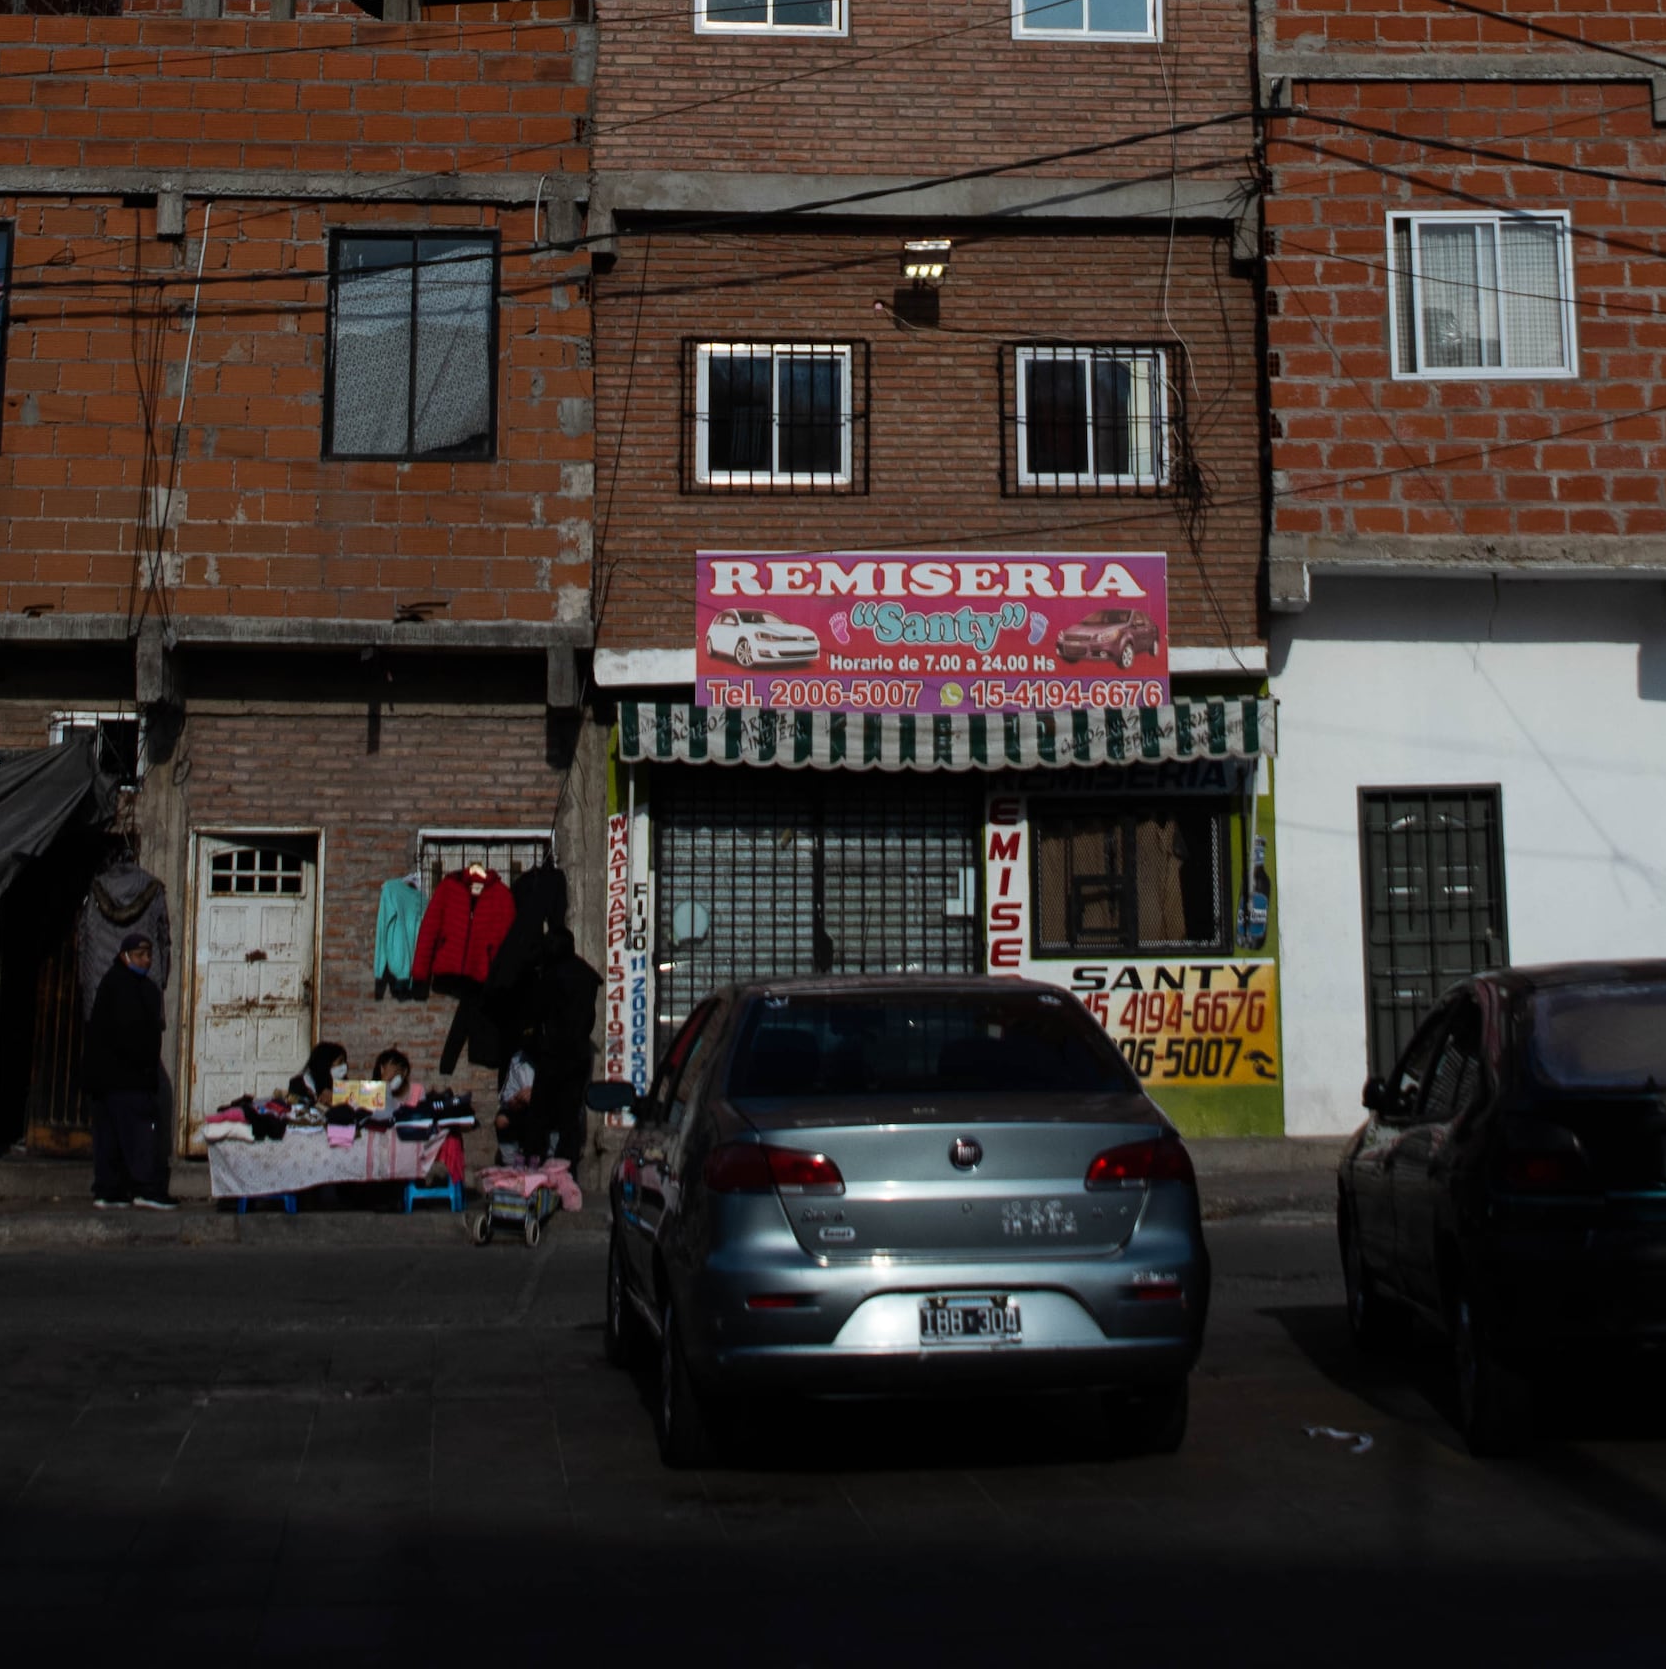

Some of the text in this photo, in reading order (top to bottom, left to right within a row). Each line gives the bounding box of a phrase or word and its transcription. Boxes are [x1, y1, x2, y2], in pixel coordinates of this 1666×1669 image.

[708, 560, 1147, 598] REMISERIA
[830, 654, 1056, 672] Horario de 7.00 a 24.00 Hs
[707, 679, 1164, 710] Tel. 2006-5007 15-4194-6676
[608, 813, 628, 948] WHATSAPP
[633, 883, 647, 950] FIJO
[1070, 965, 1261, 991] SANTY
[1119, 991, 1266, 1035] 4194-6676
